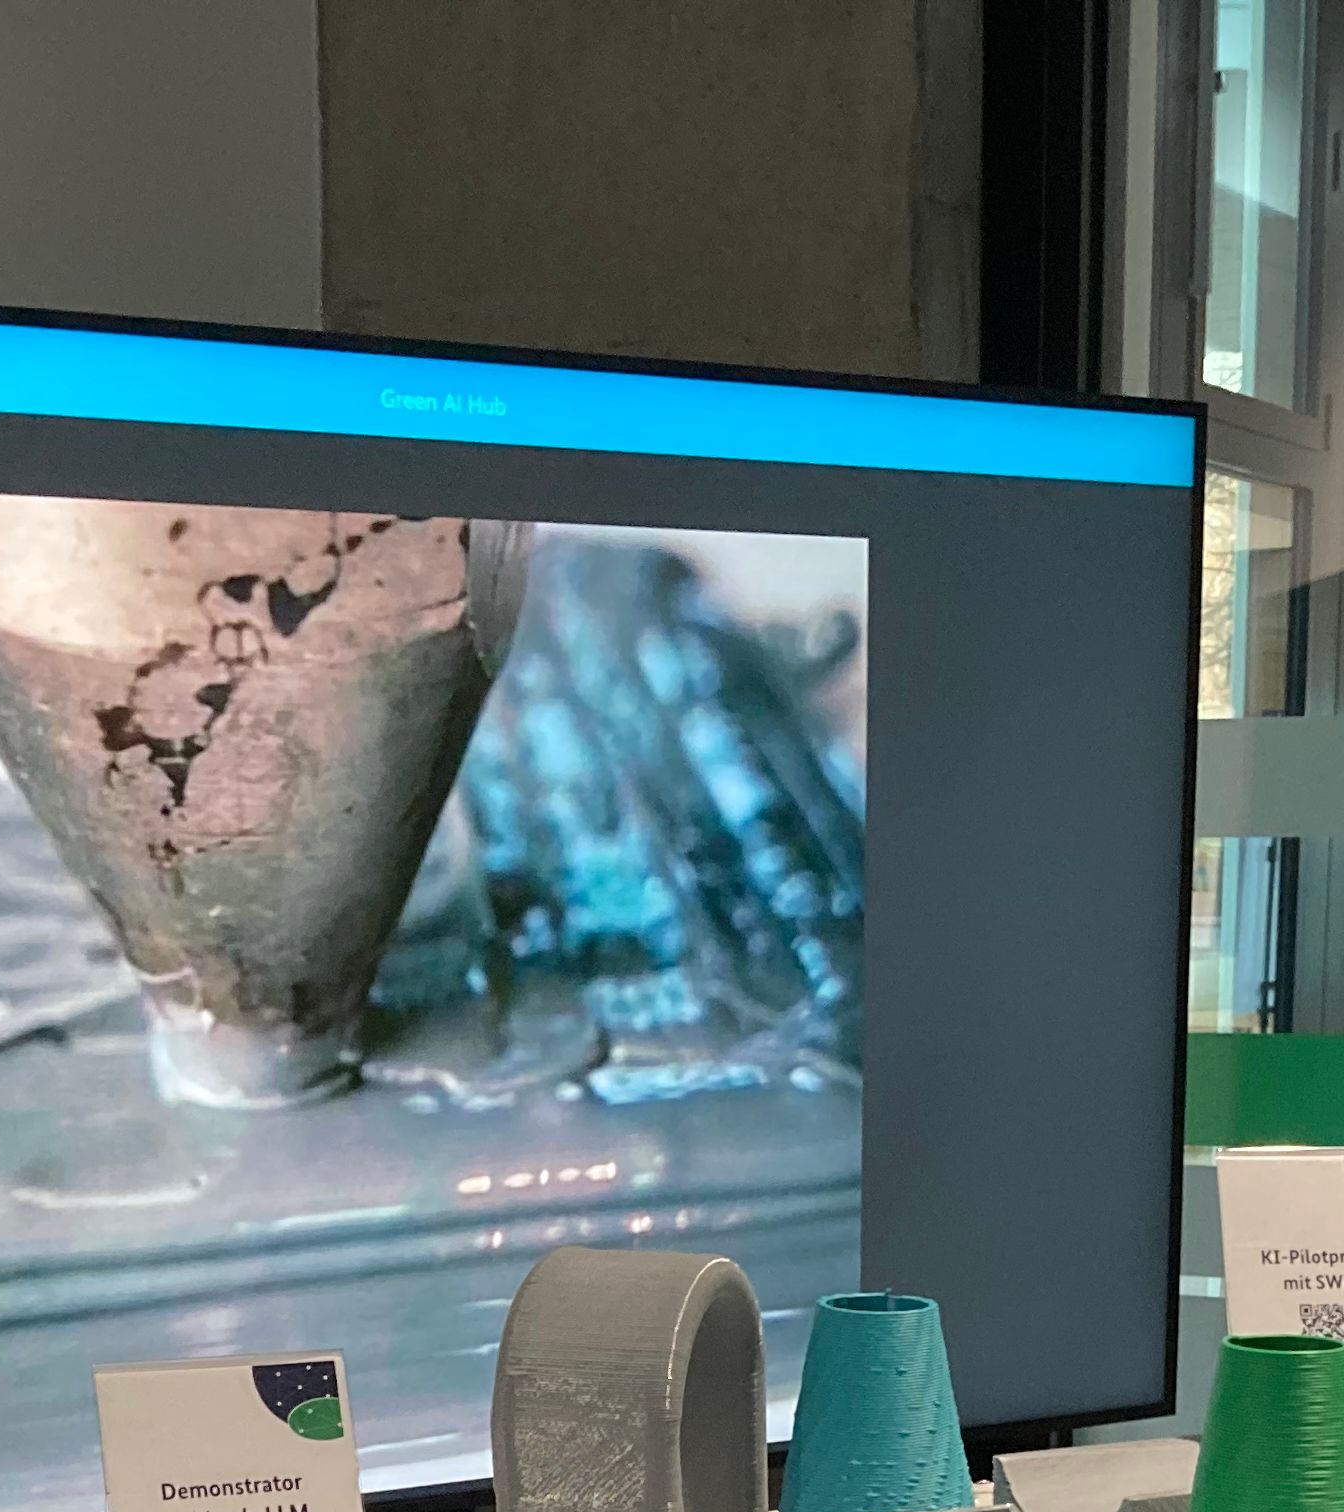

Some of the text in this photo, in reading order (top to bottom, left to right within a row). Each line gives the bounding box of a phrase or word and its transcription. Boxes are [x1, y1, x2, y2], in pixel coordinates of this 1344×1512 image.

[381, 388, 437, 410] Green
[467, 394, 507, 417] Hub
[1283, 1275, 1311, 1291] mit
[161, 1475, 303, 1501] Demonstrator
